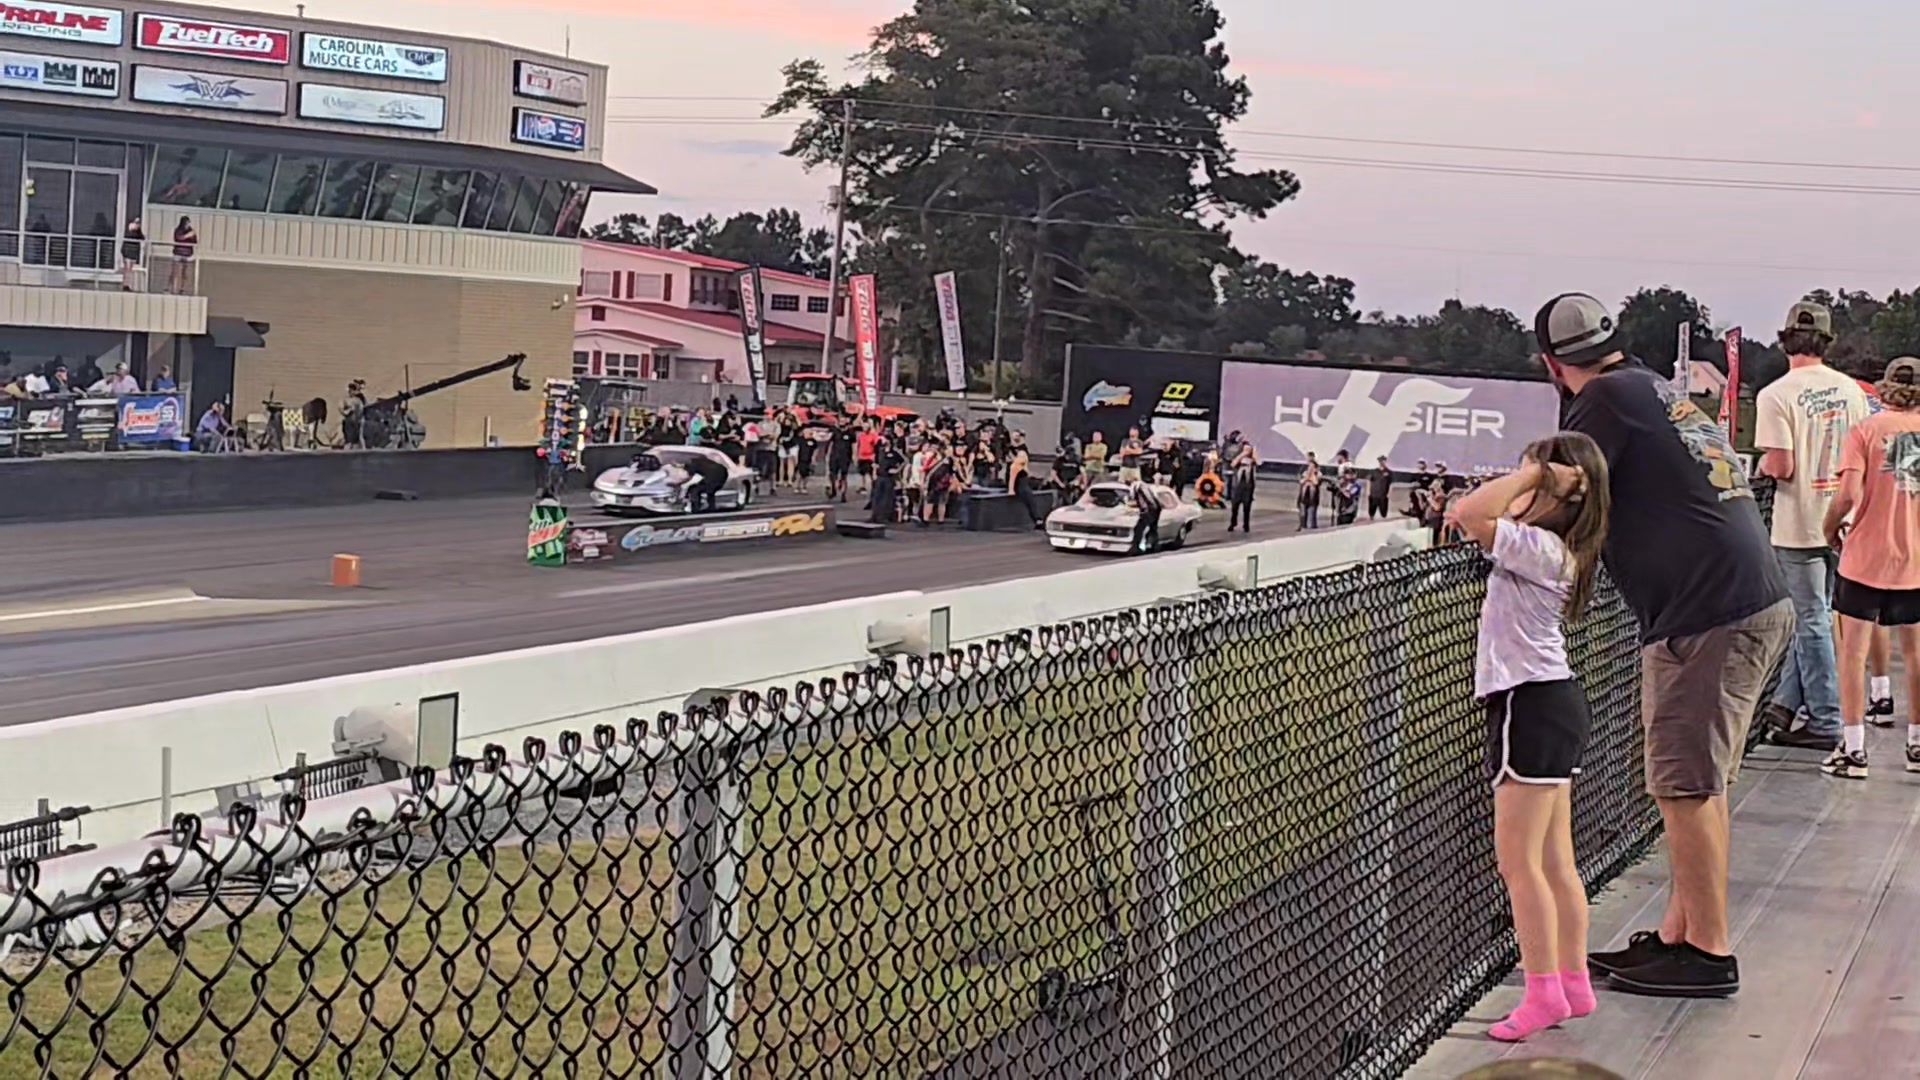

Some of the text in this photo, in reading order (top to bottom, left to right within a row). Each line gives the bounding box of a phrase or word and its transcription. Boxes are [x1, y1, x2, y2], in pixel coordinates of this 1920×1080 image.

[1, 22, 82, 37] RACING
[157, 22, 274, 53] FuelTech
[319, 38, 385, 57] CAROLINA
[309, 51, 398, 73] MUSCLE CARS
[1274, 395, 1505, 438] HOSIER
